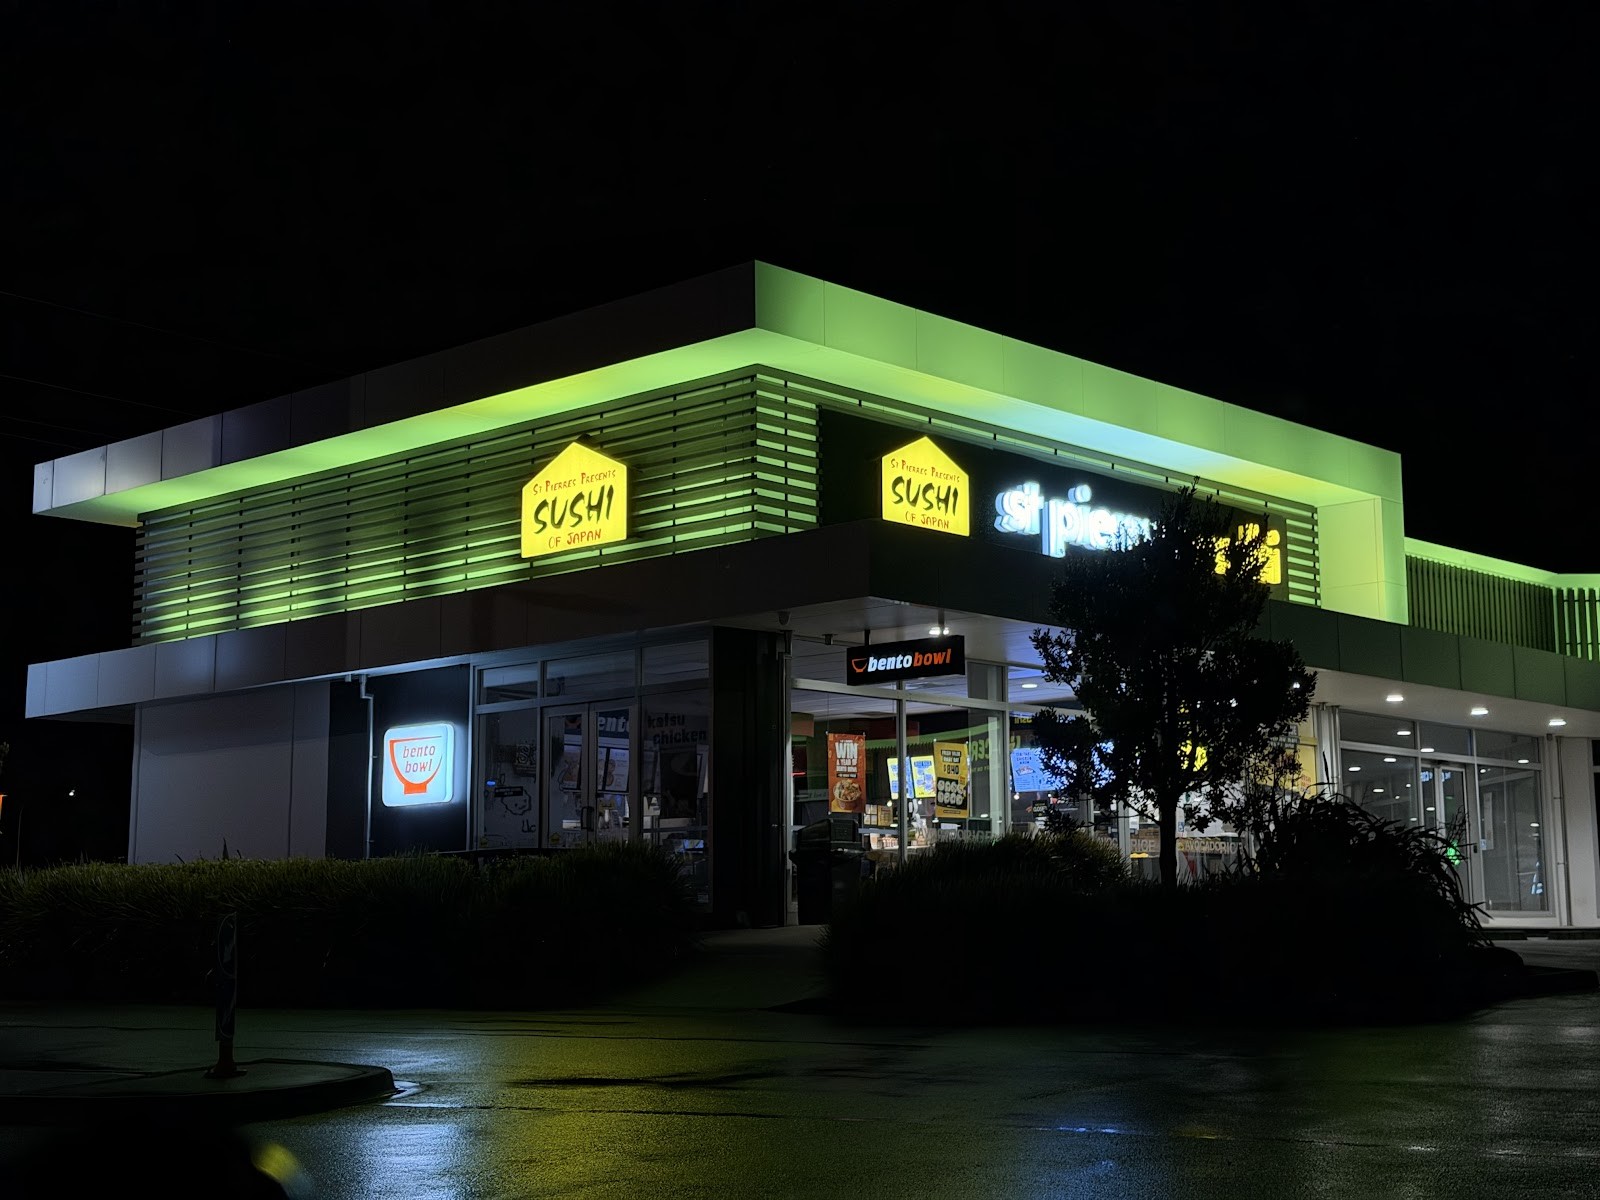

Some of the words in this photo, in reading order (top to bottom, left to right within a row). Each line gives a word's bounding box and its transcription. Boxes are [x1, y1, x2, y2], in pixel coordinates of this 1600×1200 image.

[891, 475, 959, 516] SUSHI
[534, 484, 614, 534] SUSHI
[994, 481, 1044, 535] st
[905, 511, 917, 522] OF
[920, 513, 950, 529] JAPAN
[548, 536, 561, 549] OF
[566, 528, 602, 545] JAPAN
[598, 715, 629, 732] ent
[653, 729, 707, 745] chicken
[402, 745, 436, 758] bento
[835, 742, 857, 759] WIN
[405, 759, 433, 773] bowl
